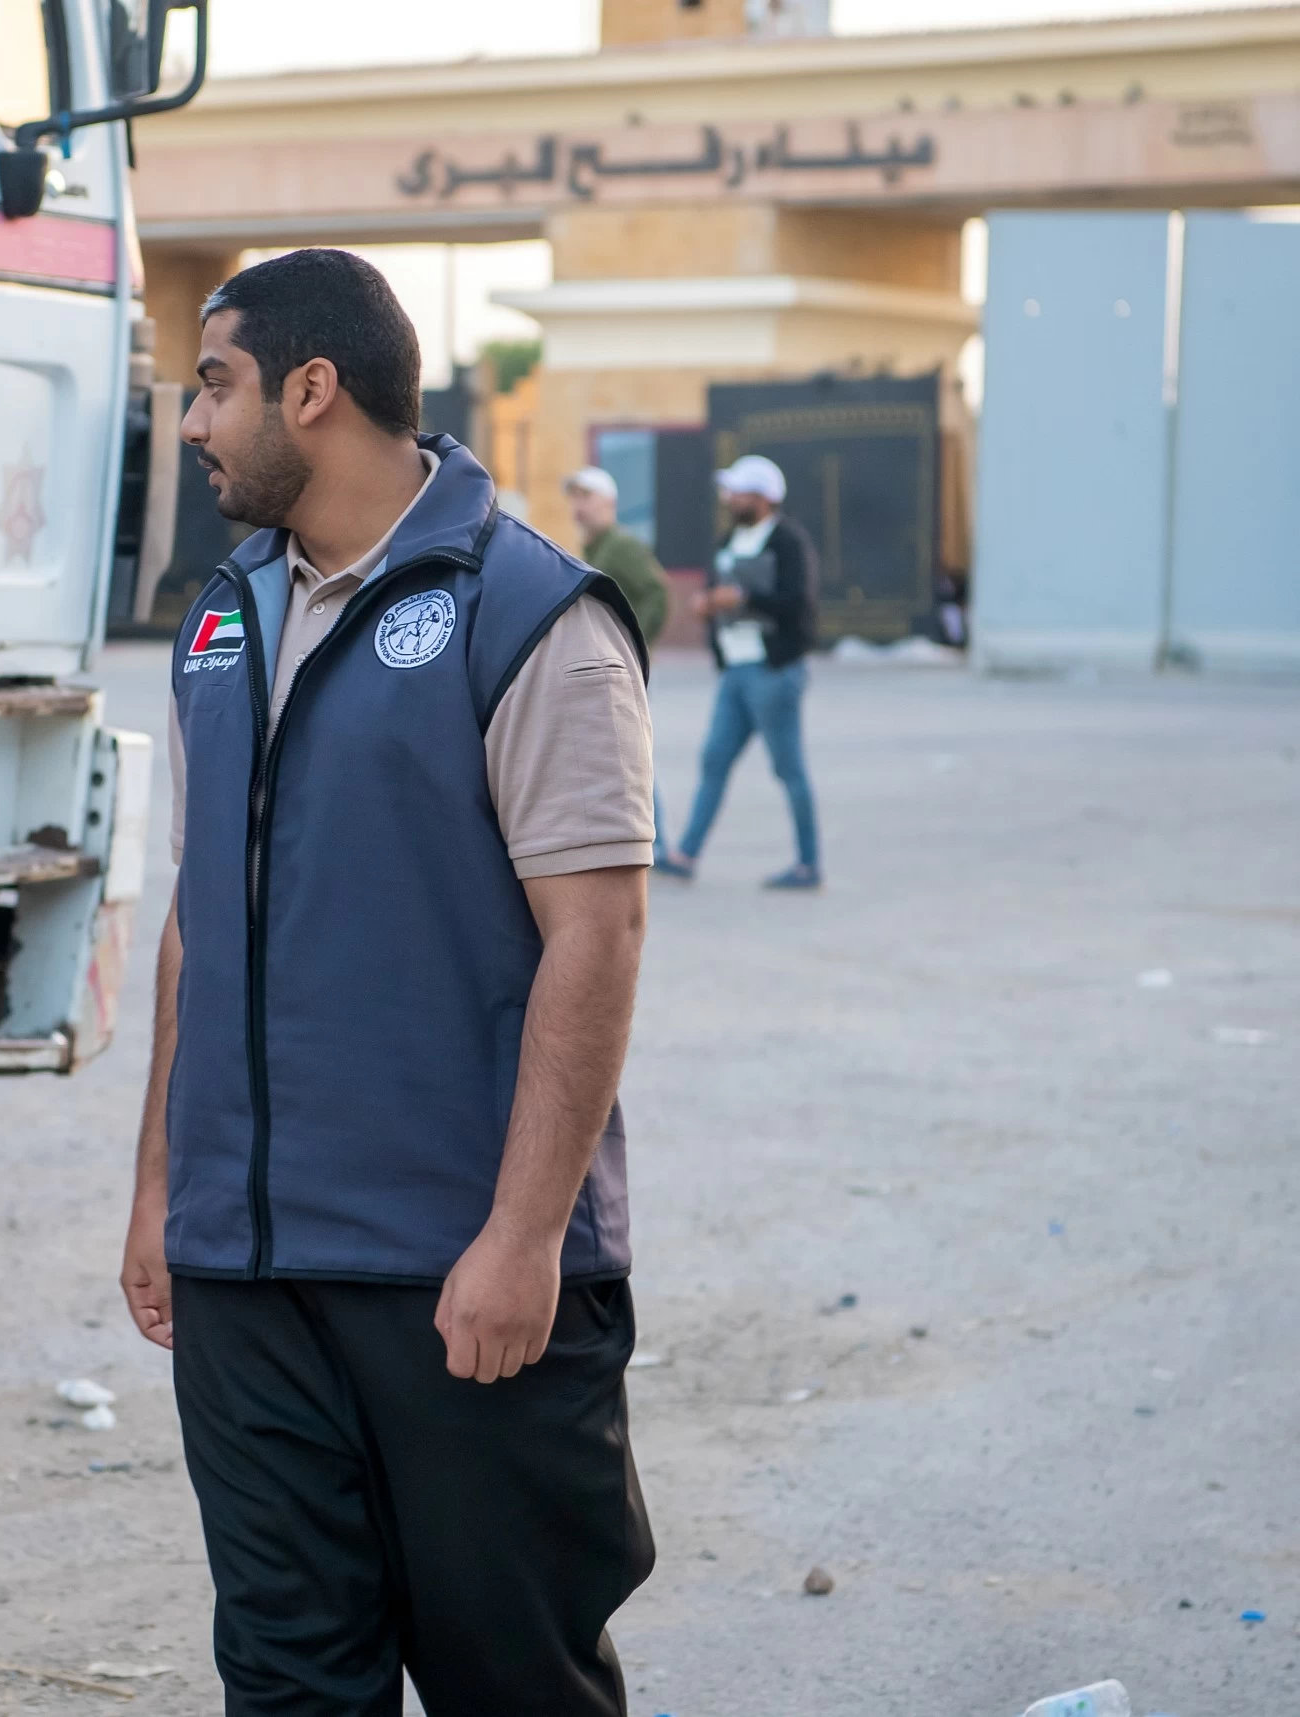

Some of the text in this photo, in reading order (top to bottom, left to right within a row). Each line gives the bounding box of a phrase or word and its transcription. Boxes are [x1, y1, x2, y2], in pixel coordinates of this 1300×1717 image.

[379, 625, 391, 659] OPERATION
[430, 631, 449, 655] KNIGHT
[183, 657, 204, 673] UAE
[202, 654, 240, 671] الإمارات
